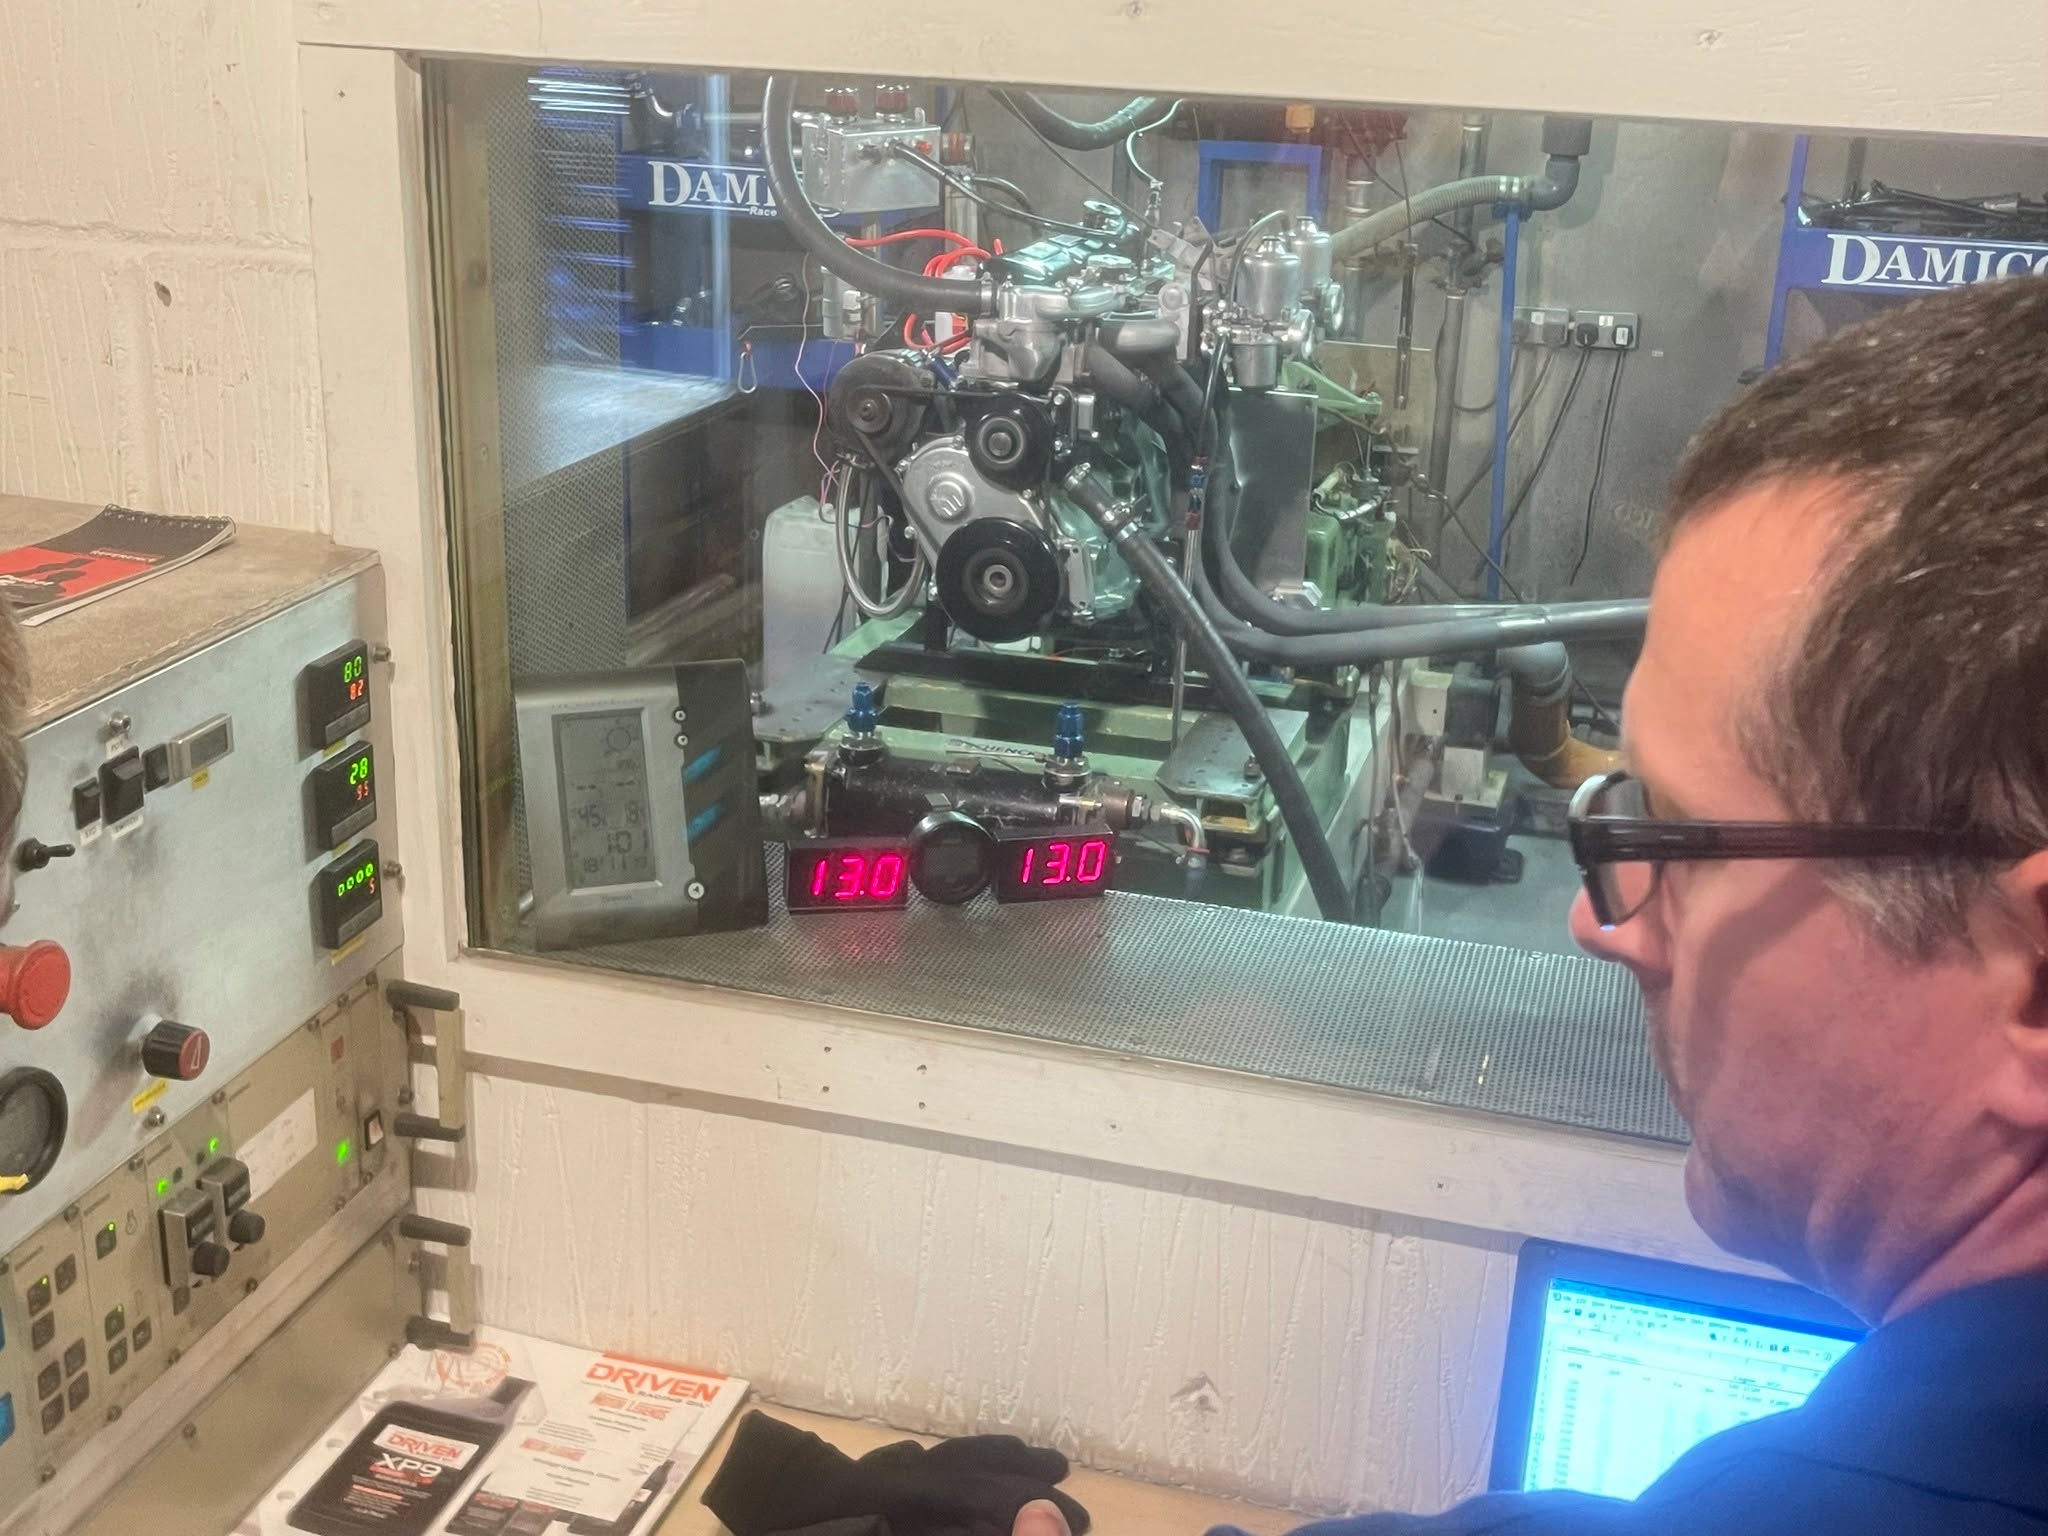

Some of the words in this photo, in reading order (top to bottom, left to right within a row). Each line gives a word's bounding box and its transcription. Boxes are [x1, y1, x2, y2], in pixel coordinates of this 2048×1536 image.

[749, 206, 778, 217] Race
[350, 757, 369, 785] 28
[811, 853, 904, 898] 13.0
[1021, 841, 1107, 885] 13.0
[585, 1362, 721, 1403] DRIVEN
[386, 1432, 462, 1459] DRIVEN
[376, 1452, 443, 1478] XP9
